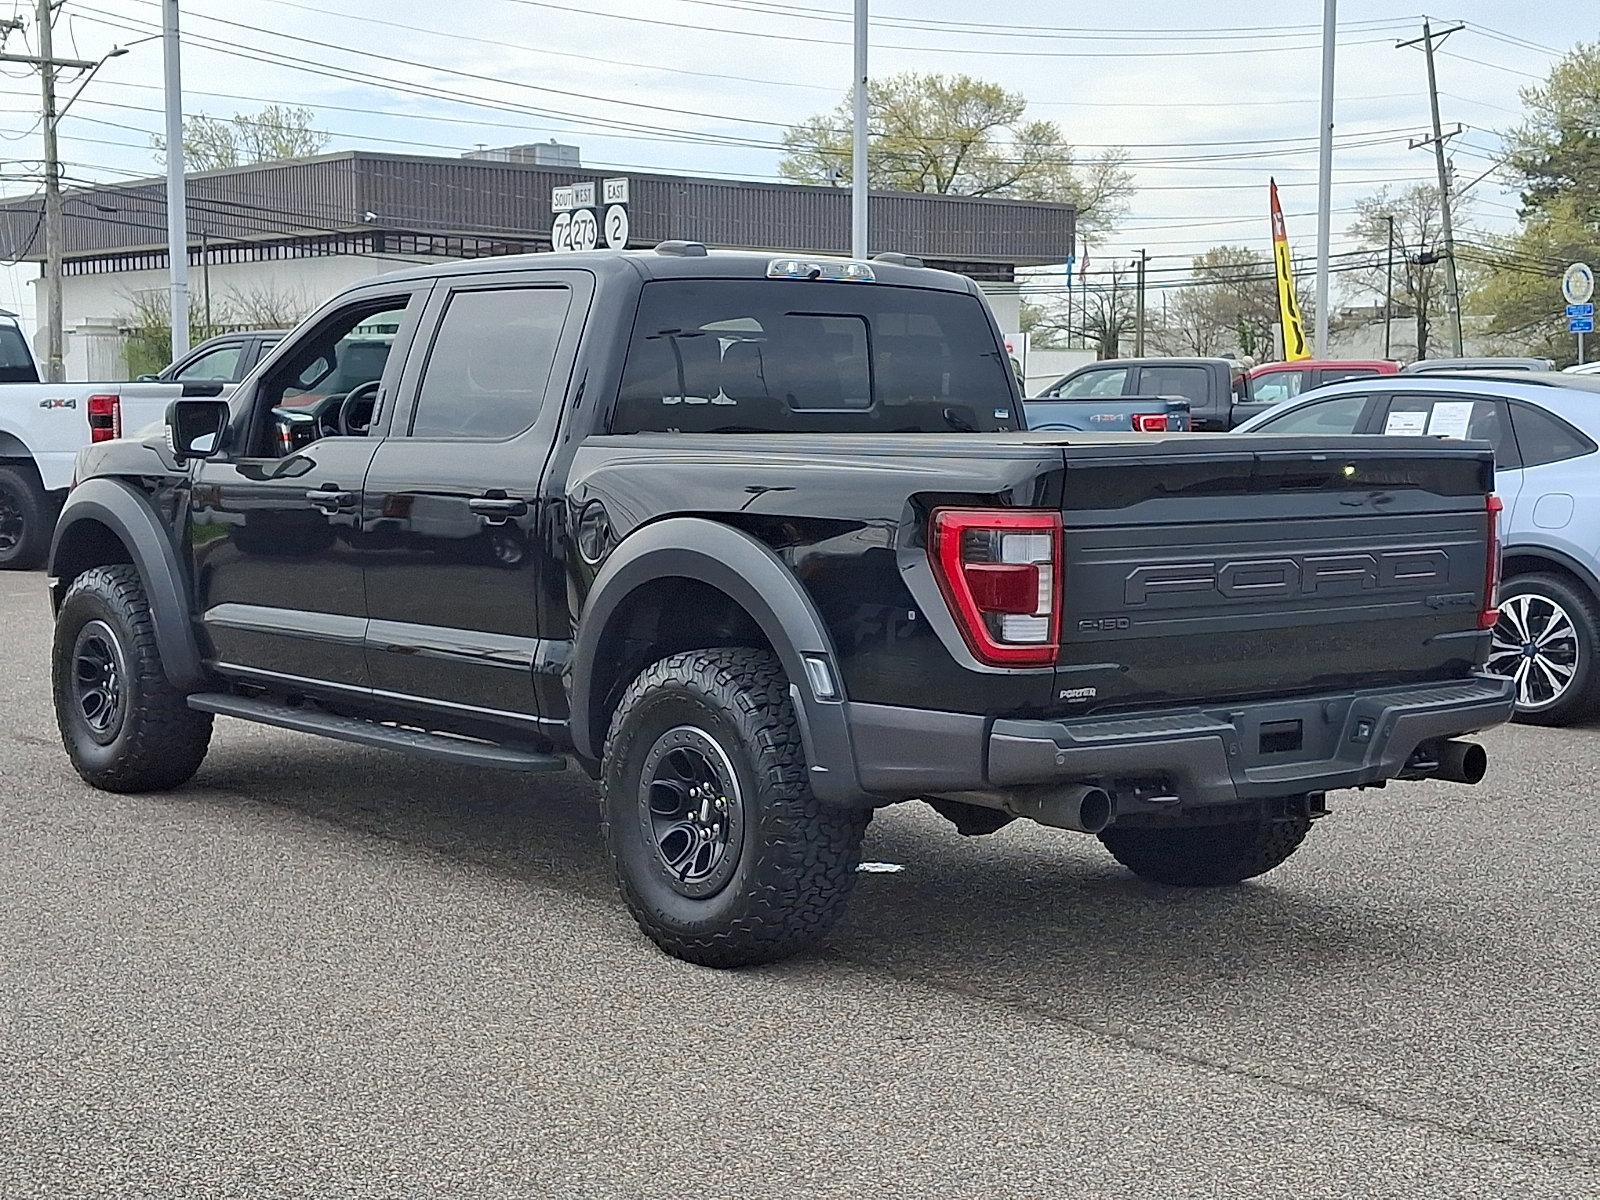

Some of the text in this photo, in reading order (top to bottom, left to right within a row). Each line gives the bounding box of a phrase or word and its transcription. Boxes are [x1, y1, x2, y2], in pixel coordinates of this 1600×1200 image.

[554, 193, 572, 207] SOUT
[574, 188, 592, 203] WEST
[607, 184, 624, 200] EAST
[555, 222, 571, 248] 72
[573, 219, 595, 248] 273
[612, 215, 622, 241] 2
[1124, 549, 1449, 605] FORD
[1078, 616, 1130, 632] F-150
[1059, 687, 1097, 699] PORTER
